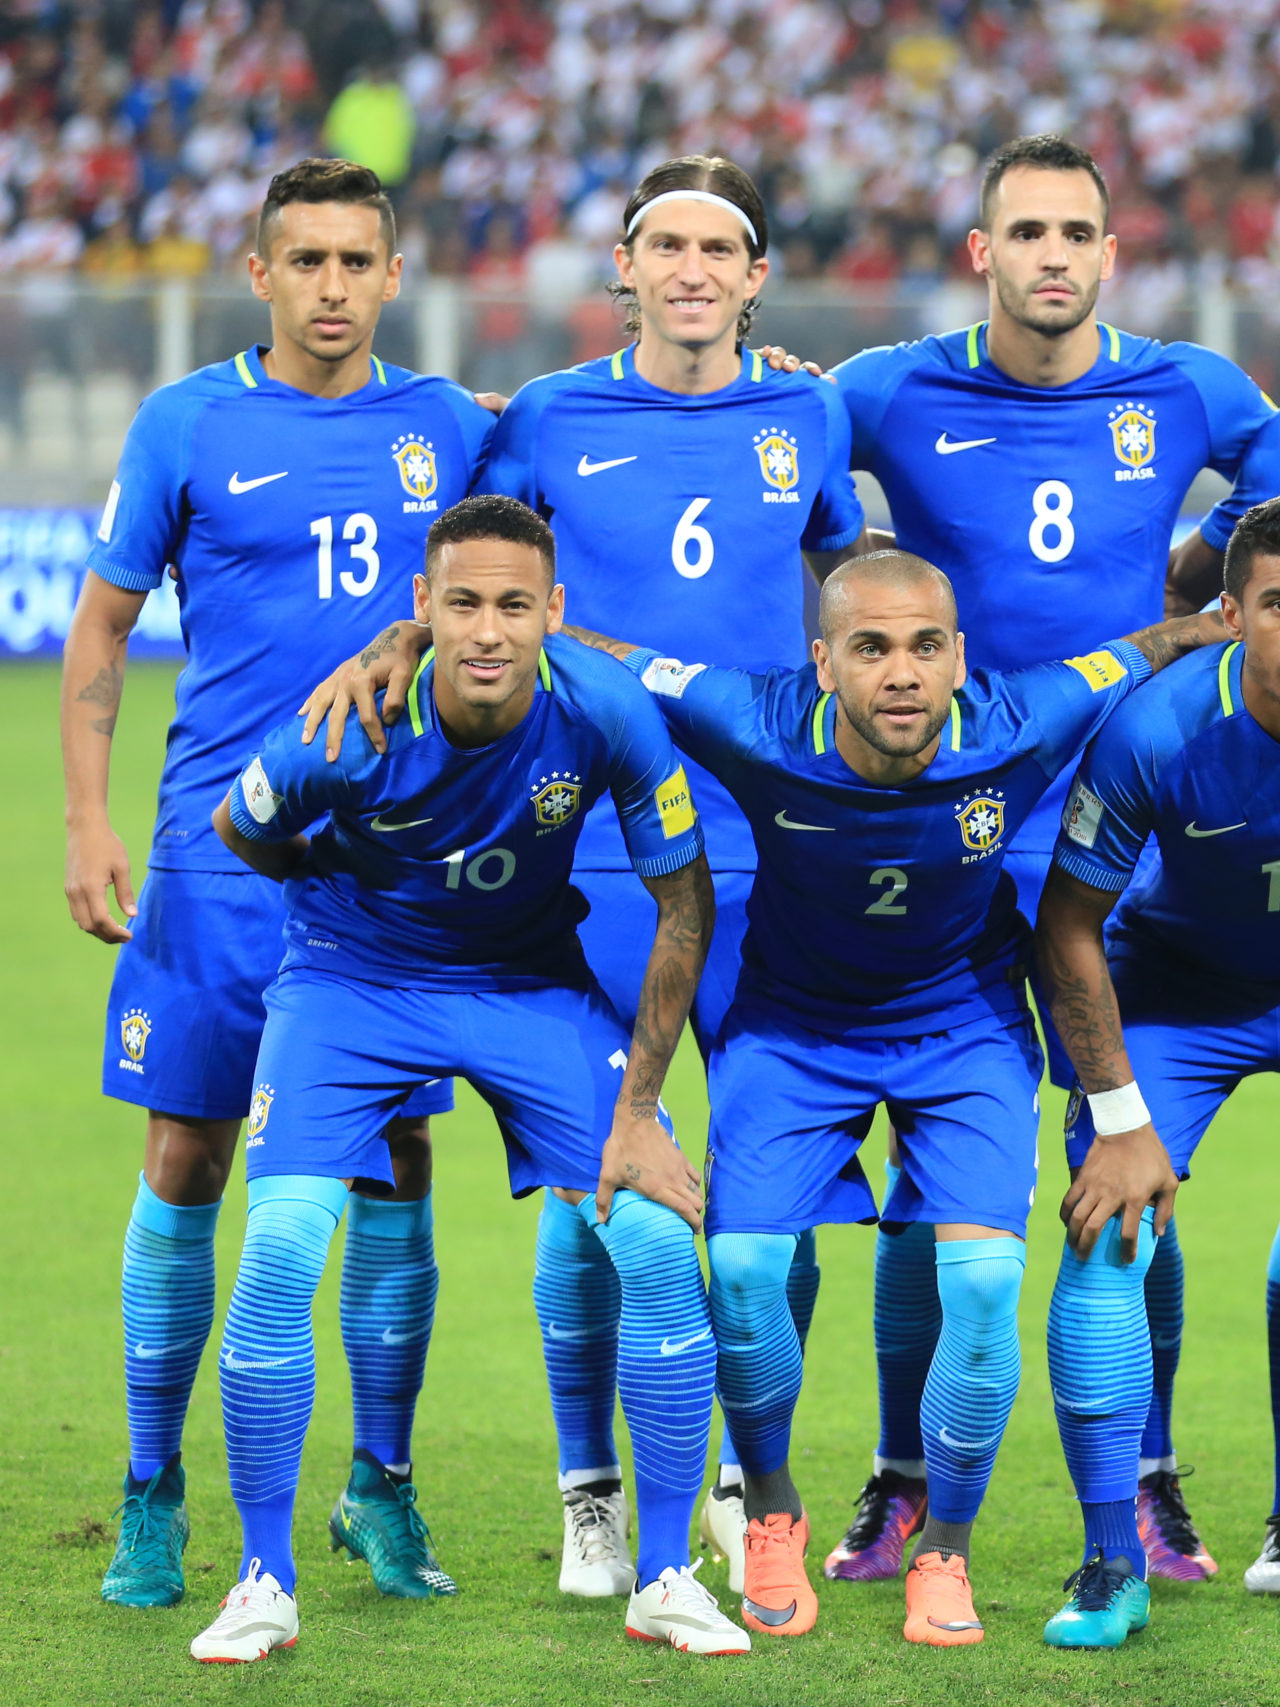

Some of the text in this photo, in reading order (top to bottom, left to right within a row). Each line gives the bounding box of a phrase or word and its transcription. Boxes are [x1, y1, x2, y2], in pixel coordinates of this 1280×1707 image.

[1115, 467, 1156, 481] BRASIL
[403, 500, 438, 513] BRASIL
[763, 491, 800, 503] BRASIL
[1029, 480, 1075, 563] 8
[672, 497, 714, 579] 6
[310, 513, 380, 599] 13
[662, 791, 687, 811] FIFA
[976, 820, 990, 829] CBF
[962, 842, 1003, 865] BRASIL
[443, 848, 517, 890] 10
[864, 868, 908, 915] 2
